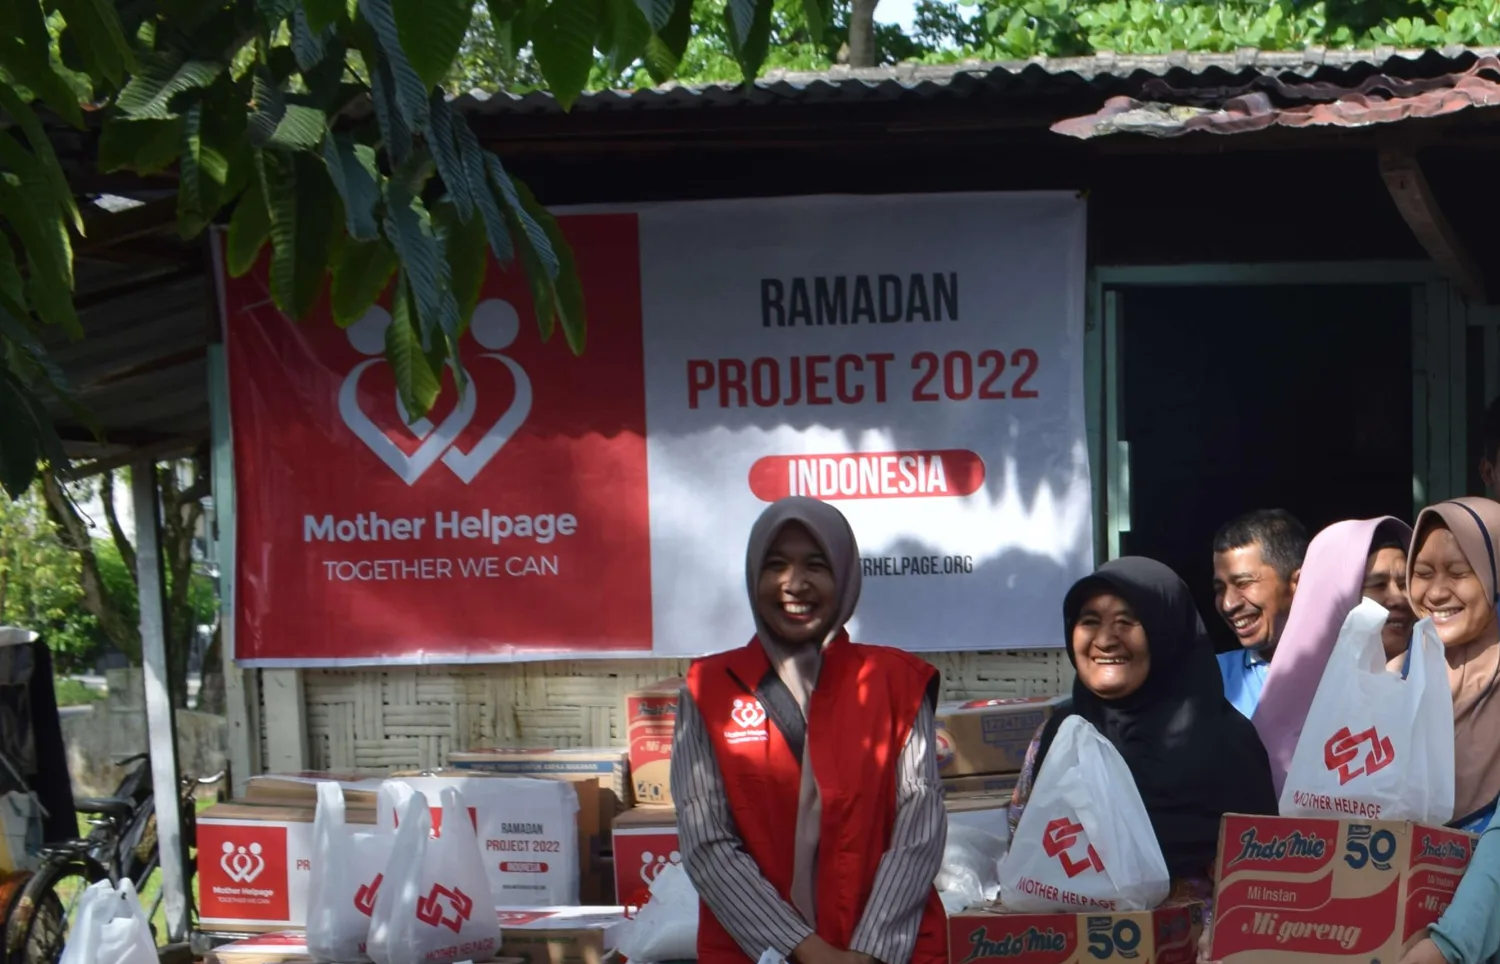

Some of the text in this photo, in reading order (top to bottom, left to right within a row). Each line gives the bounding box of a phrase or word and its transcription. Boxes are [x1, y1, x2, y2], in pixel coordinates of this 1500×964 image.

[760, 272, 958, 327] RAMADAN
[687, 349, 1039, 410] PROJECT 2022
[788, 455, 948, 497] INDONESIA
[303, 508, 577, 545] Mother Helpage
[323, 555, 559, 581] TOGETHER WE CAN
[1293, 790, 1381, 819] MOTHER HELPAGE
[486, 840, 560, 852] PROJECT 2022
[501, 823, 543, 834] RAMADAN
[1343, 824, 1397, 871] 50
[1016, 876, 1116, 911] MOTHER HELPAGE
[1247, 886, 1297, 902] Mi Instan
[1087, 916, 1141, 959] 50
[1241, 912, 1362, 950] Mi goreng
